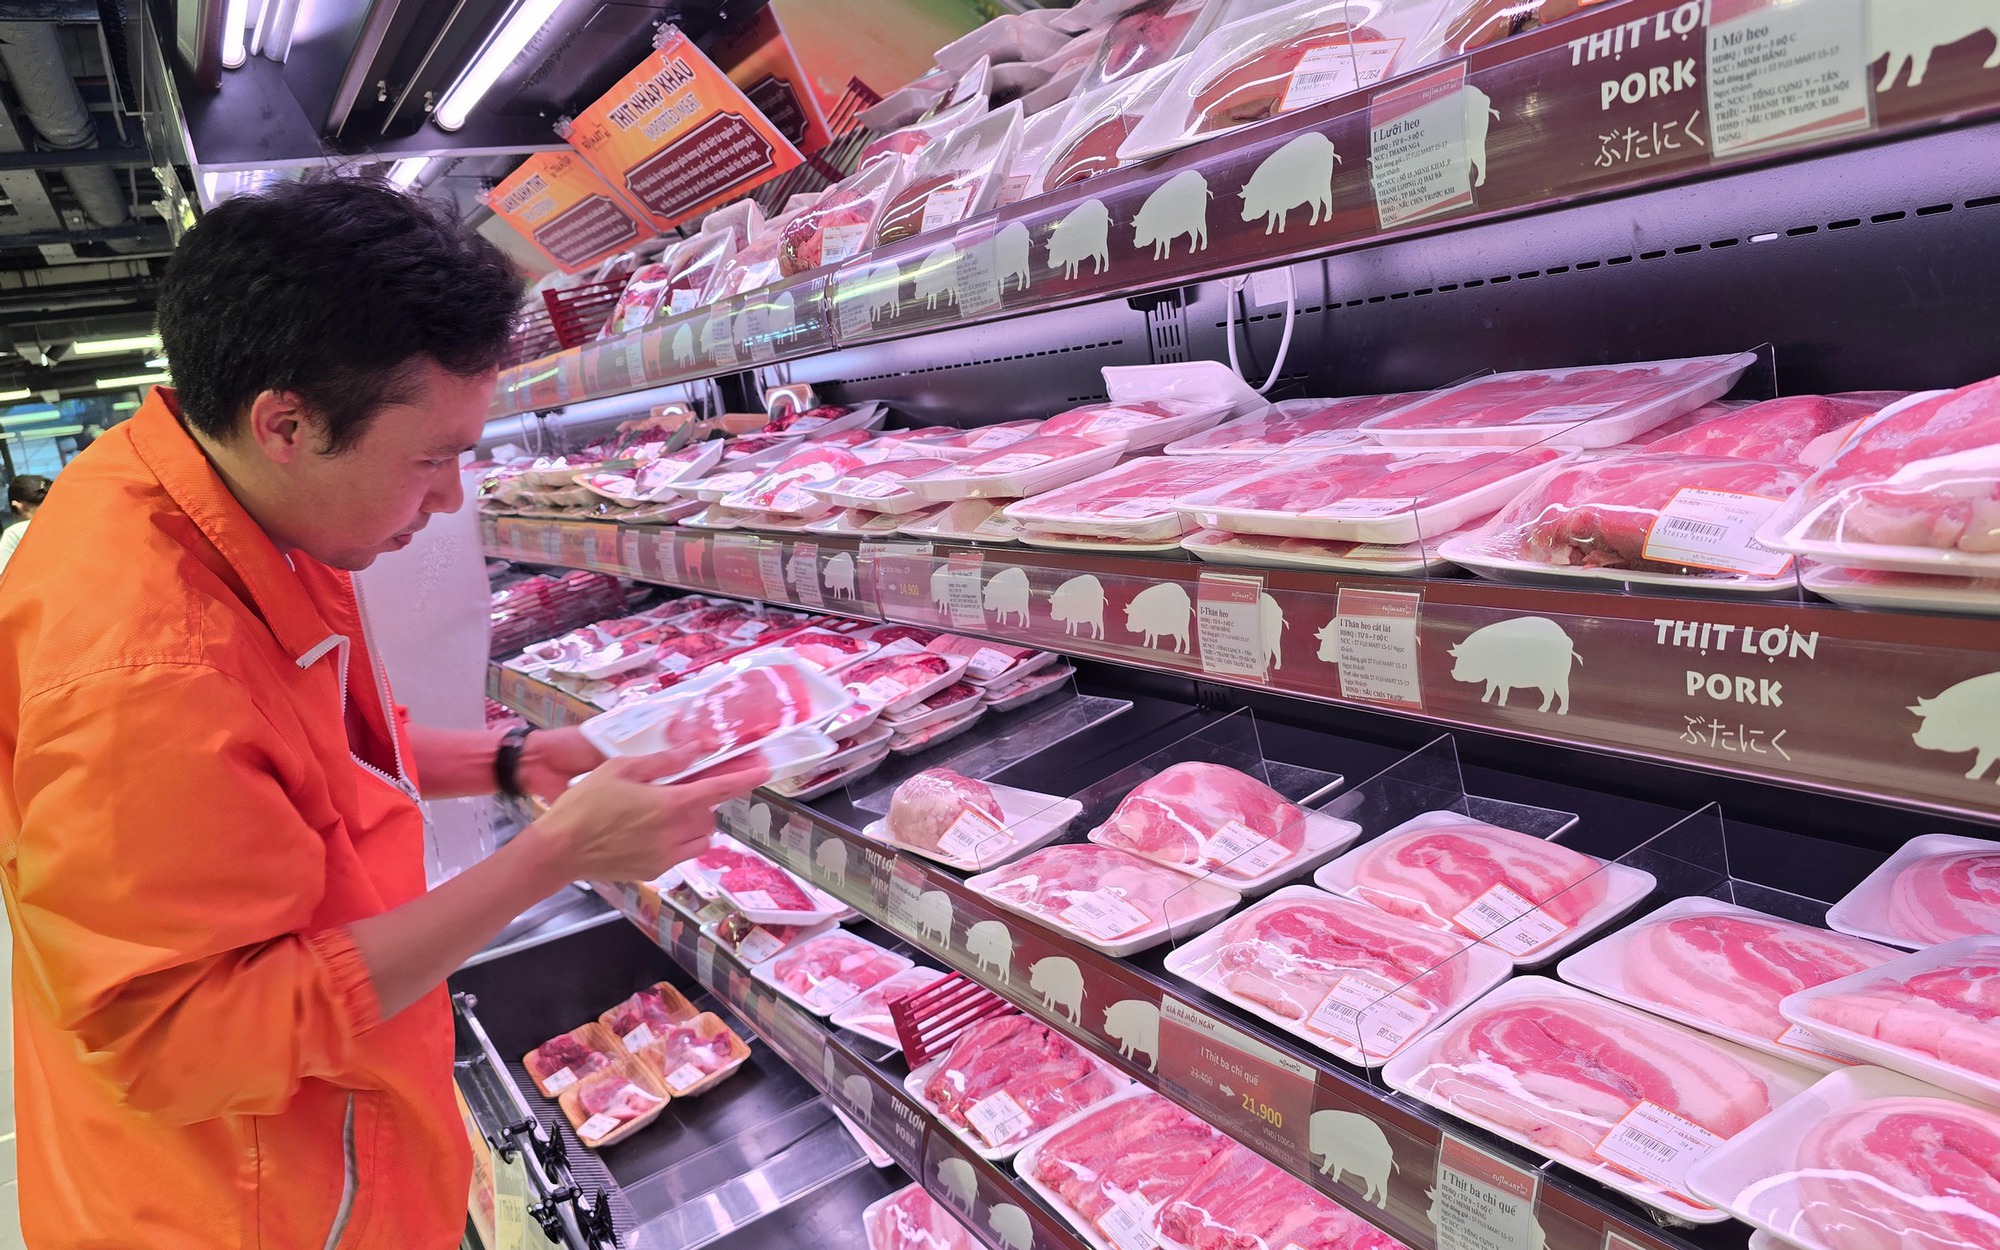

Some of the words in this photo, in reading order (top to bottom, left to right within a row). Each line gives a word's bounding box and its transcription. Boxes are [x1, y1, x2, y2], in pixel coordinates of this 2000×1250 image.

[1568, 17, 1647, 66] THỊT
[1655, 0, 1711, 42] LỢ
[1746, 25, 1769, 41] heo
[1601, 57, 1696, 110] PORK
[1374, 132, 1376, 142] I
[1380, 122, 1401, 140] Lưỡi
[1404, 119, 1420, 131] heo
[1595, 110, 1705, 167] ぶたにく
[1360, 622, 1371, 631] heo
[1372, 623, 1382, 632] cắt
[1382, 623, 1391, 633] lát
[1653, 618, 1735, 656] THỊT
[1741, 624, 1819, 664] LỢN
[1686, 670, 1783, 708] PORK
[1680, 715, 1791, 761] ぶたにく
[1166, 1005, 1176, 1015] GIÁ
[1198, 1019, 1215, 1030] NGÀY
[1205, 1048, 1219, 1066] Thịt
[1221, 1058, 1229, 1070] ba
[1231, 1065, 1242, 1078] chỉ
[908, 1110, 926, 1133] LỢN
[1242, 1093, 1282, 1128] 21.900
[895, 1123, 916, 1149] PORK
[1442, 1170, 1447, 1180] I
[1449, 1172, 1467, 1192] Thịt
[1469, 1184, 1481, 1198] ba
[1483, 1193, 1497, 1206] chỉ
[1498, 1203, 1518, 1216] quế
